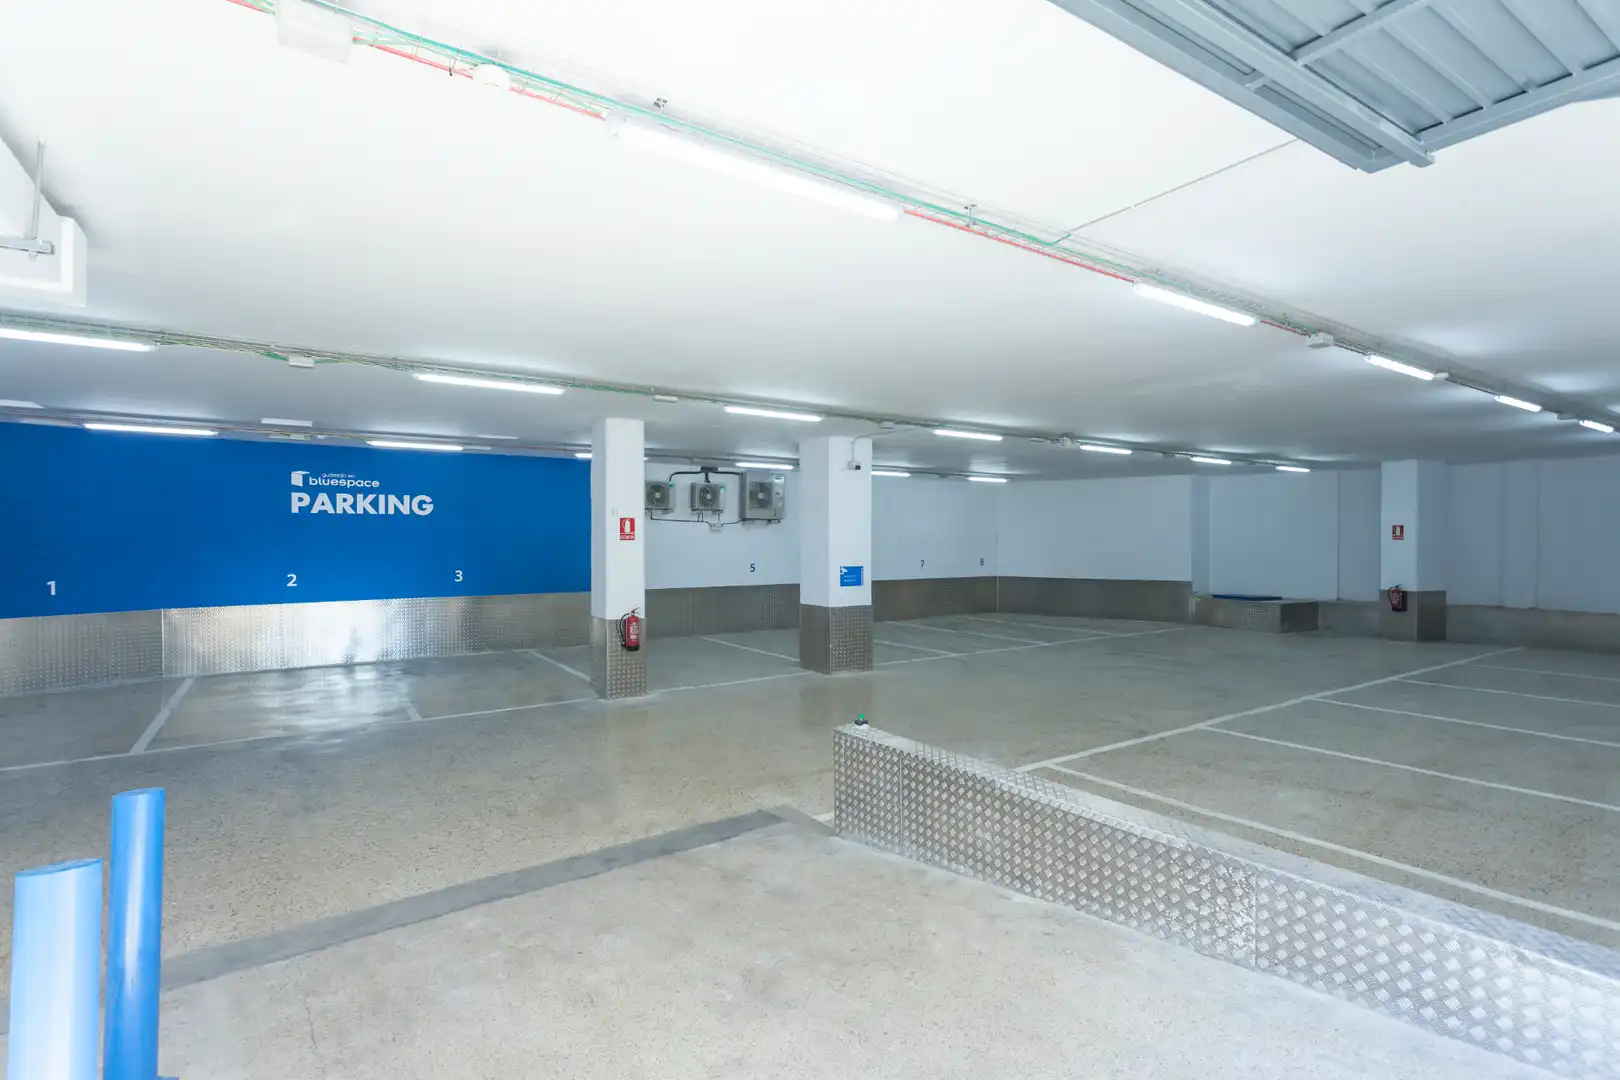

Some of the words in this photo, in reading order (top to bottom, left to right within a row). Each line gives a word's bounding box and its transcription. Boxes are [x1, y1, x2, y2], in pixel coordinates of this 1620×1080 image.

[309, 476, 380, 489] bluespace
[291, 492, 434, 516] PARKING
[749, 563, 756, 573] 5
[920, 559, 925, 569] 7
[286, 573, 298, 587] 2
[454, 569, 463, 582] 3
[47, 580, 56, 596] 1
